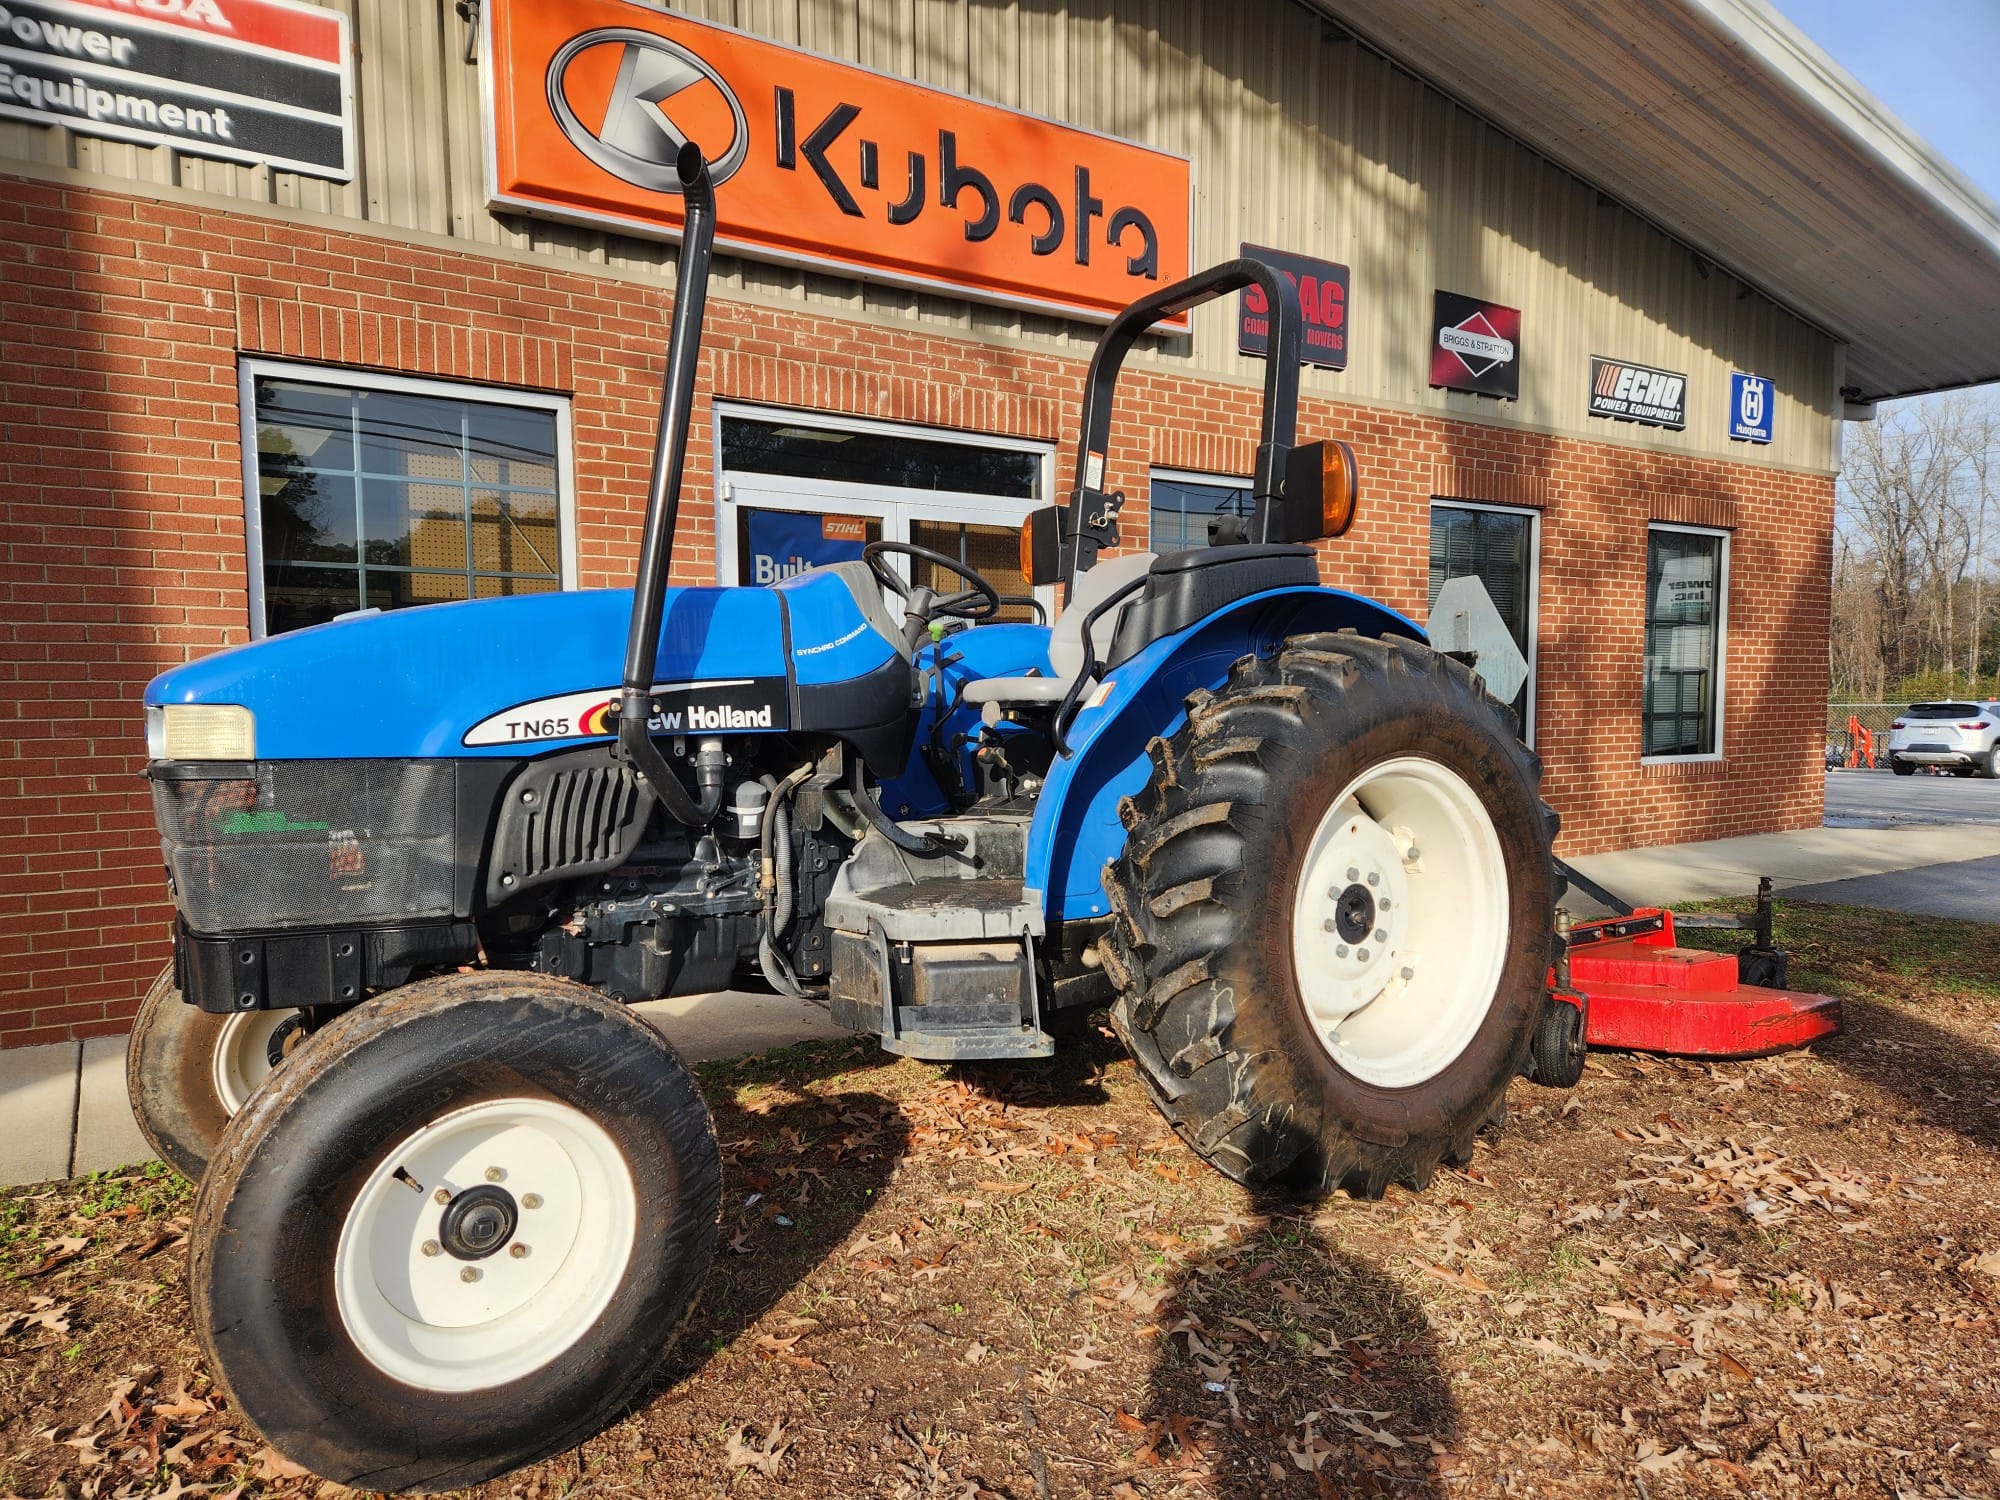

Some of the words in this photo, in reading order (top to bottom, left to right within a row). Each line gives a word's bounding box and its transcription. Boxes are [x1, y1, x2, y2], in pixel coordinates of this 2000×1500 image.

[774, 85, 1158, 281] Kubota
[1246, 270, 1344, 329] SAG
[1307, 329, 1343, 351] MOWERS
[1443, 333, 1470, 348] BRIGGS
[1471, 339, 1476, 349] &
[1476, 340, 1510, 356] STRATTON
[1614, 367, 1683, 409] ECHO
[1593, 396, 1628, 412] POWER
[1629, 403, 1681, 422] EQUIPMENT
[825, 522, 862, 534] STIHL
[796, 642, 835, 656] SYNCHRO
[834, 622, 868, 647] COMMAND
[505, 718, 569, 738] TN65
[646, 712, 682, 730] ew
[687, 704, 772, 729] Holland
